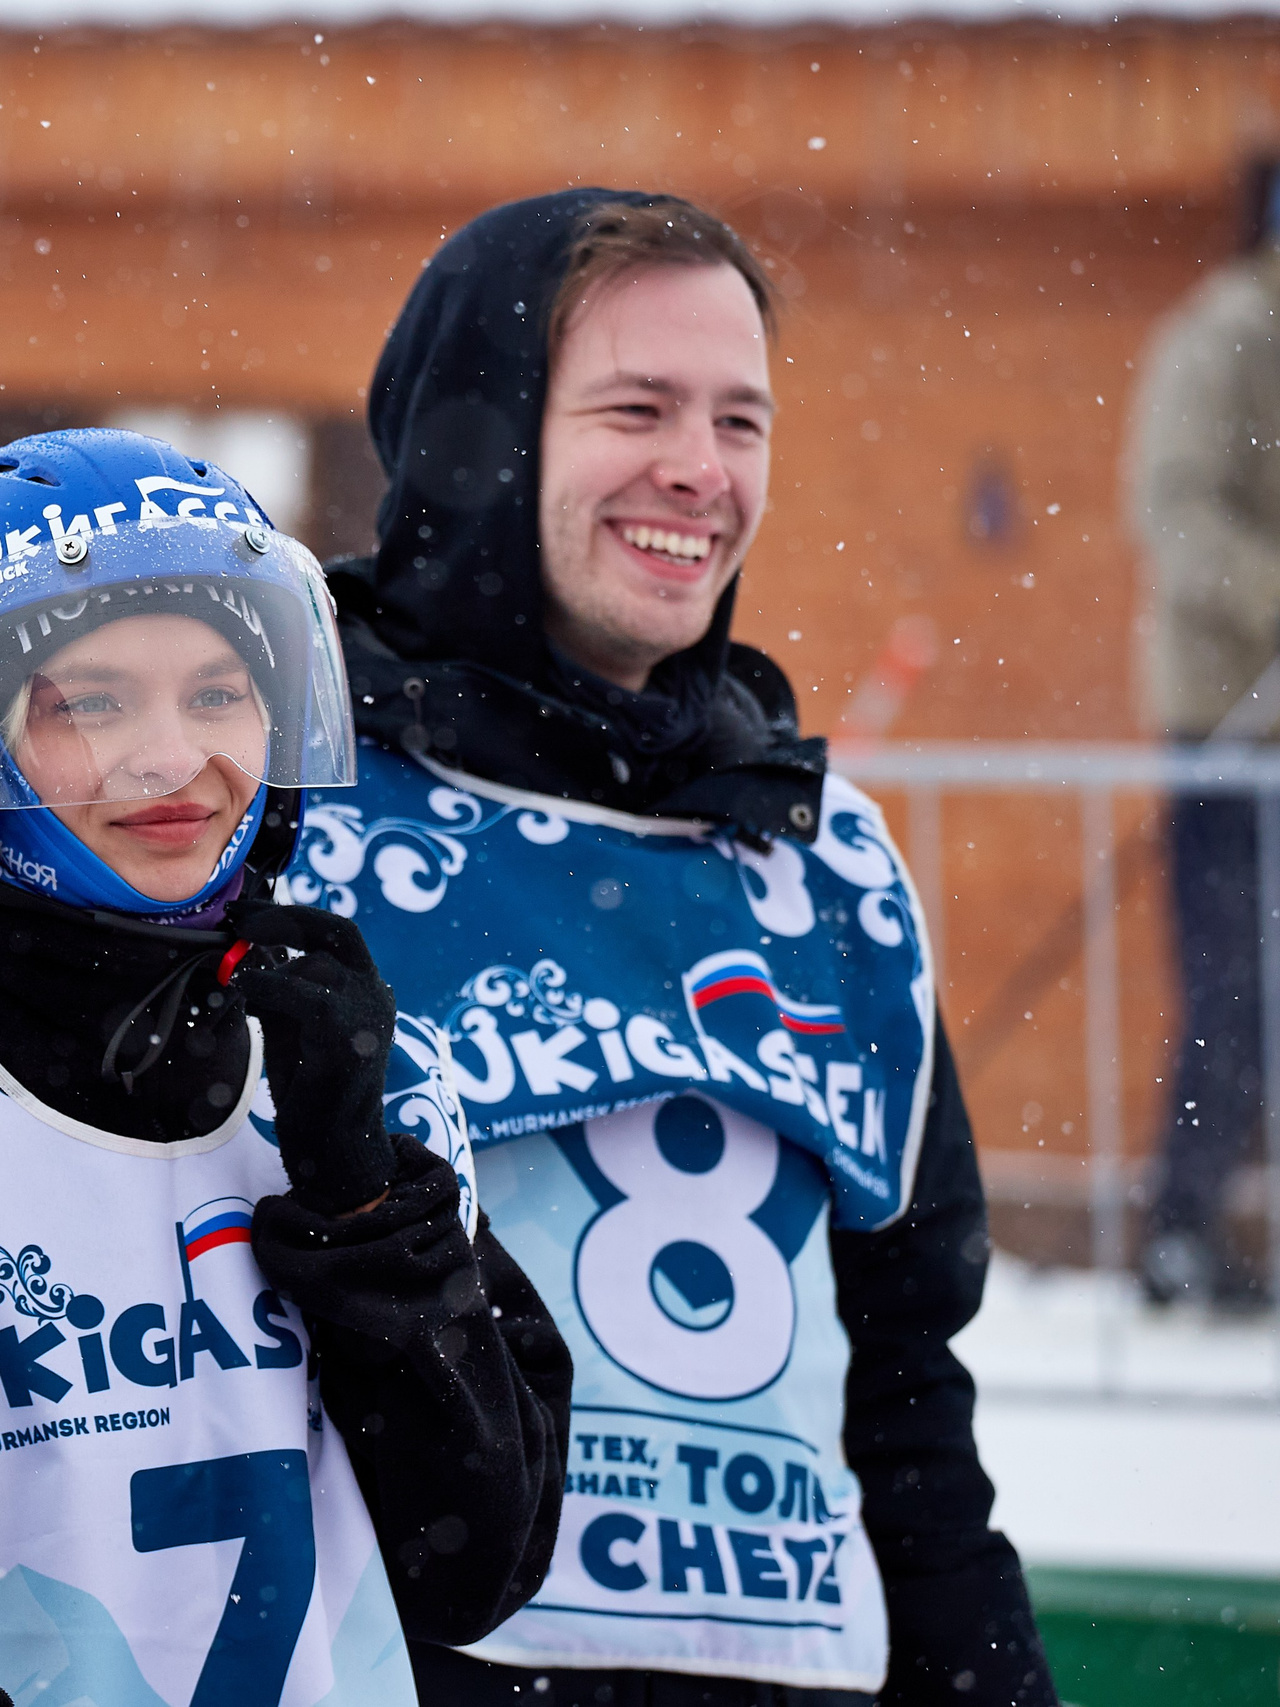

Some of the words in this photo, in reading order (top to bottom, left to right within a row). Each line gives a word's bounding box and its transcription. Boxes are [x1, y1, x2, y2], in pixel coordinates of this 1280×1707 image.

[575, 1092, 795, 1402] 8
[94, 1406, 171, 1433] REGION
[130, 1448, 316, 1707] 7
